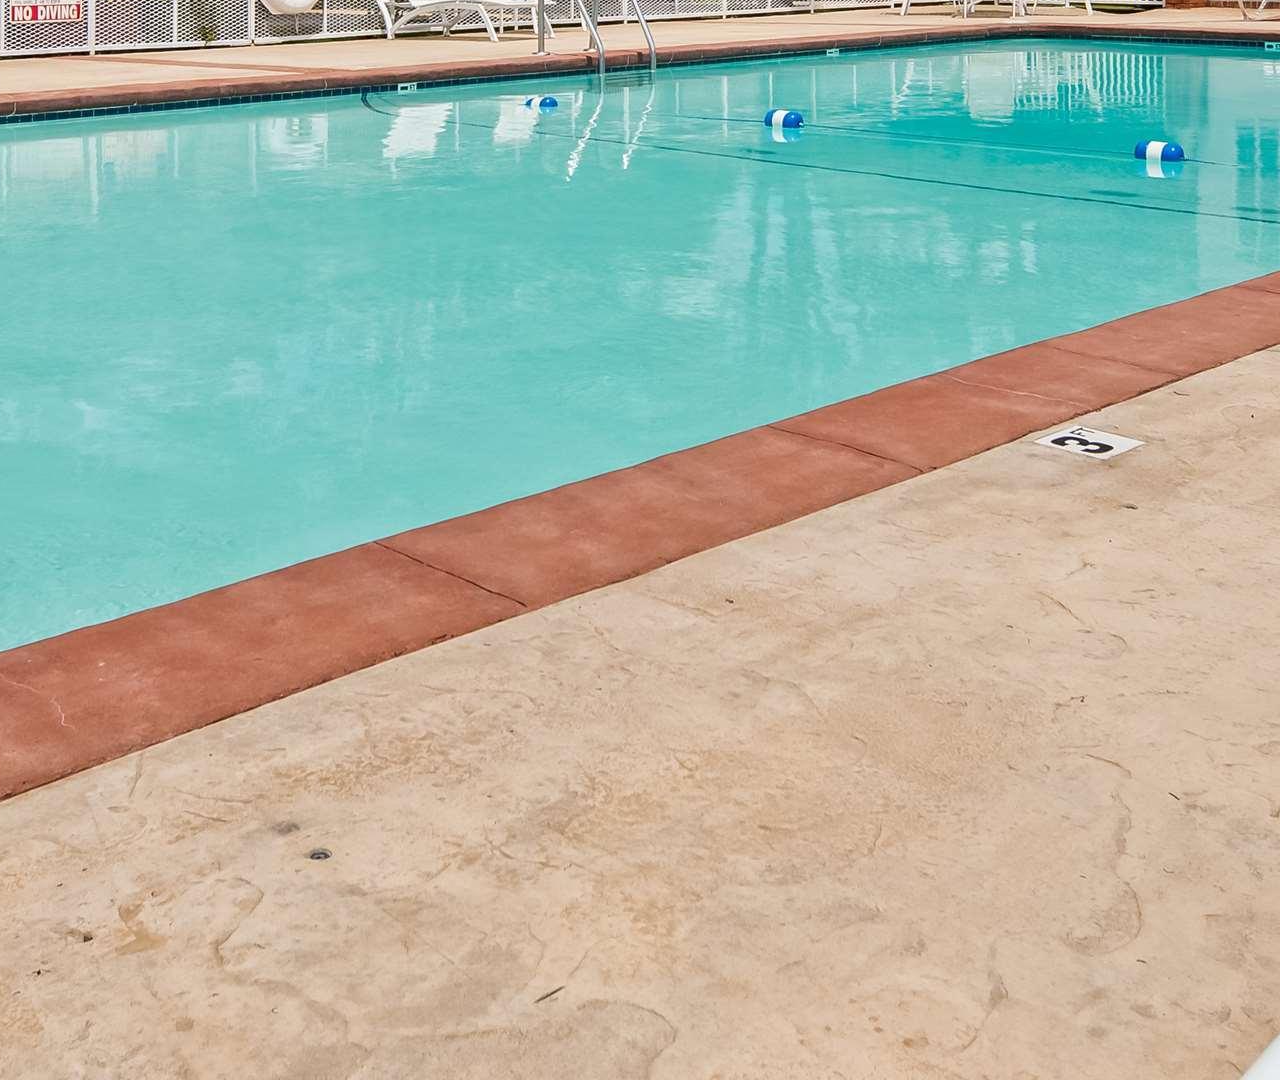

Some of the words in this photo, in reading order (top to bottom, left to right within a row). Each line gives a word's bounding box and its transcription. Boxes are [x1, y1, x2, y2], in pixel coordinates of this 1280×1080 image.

[14, 6, 32, 21] NO
[37, 5, 78, 20] DIVING
[1050, 436, 1114, 454] 3
